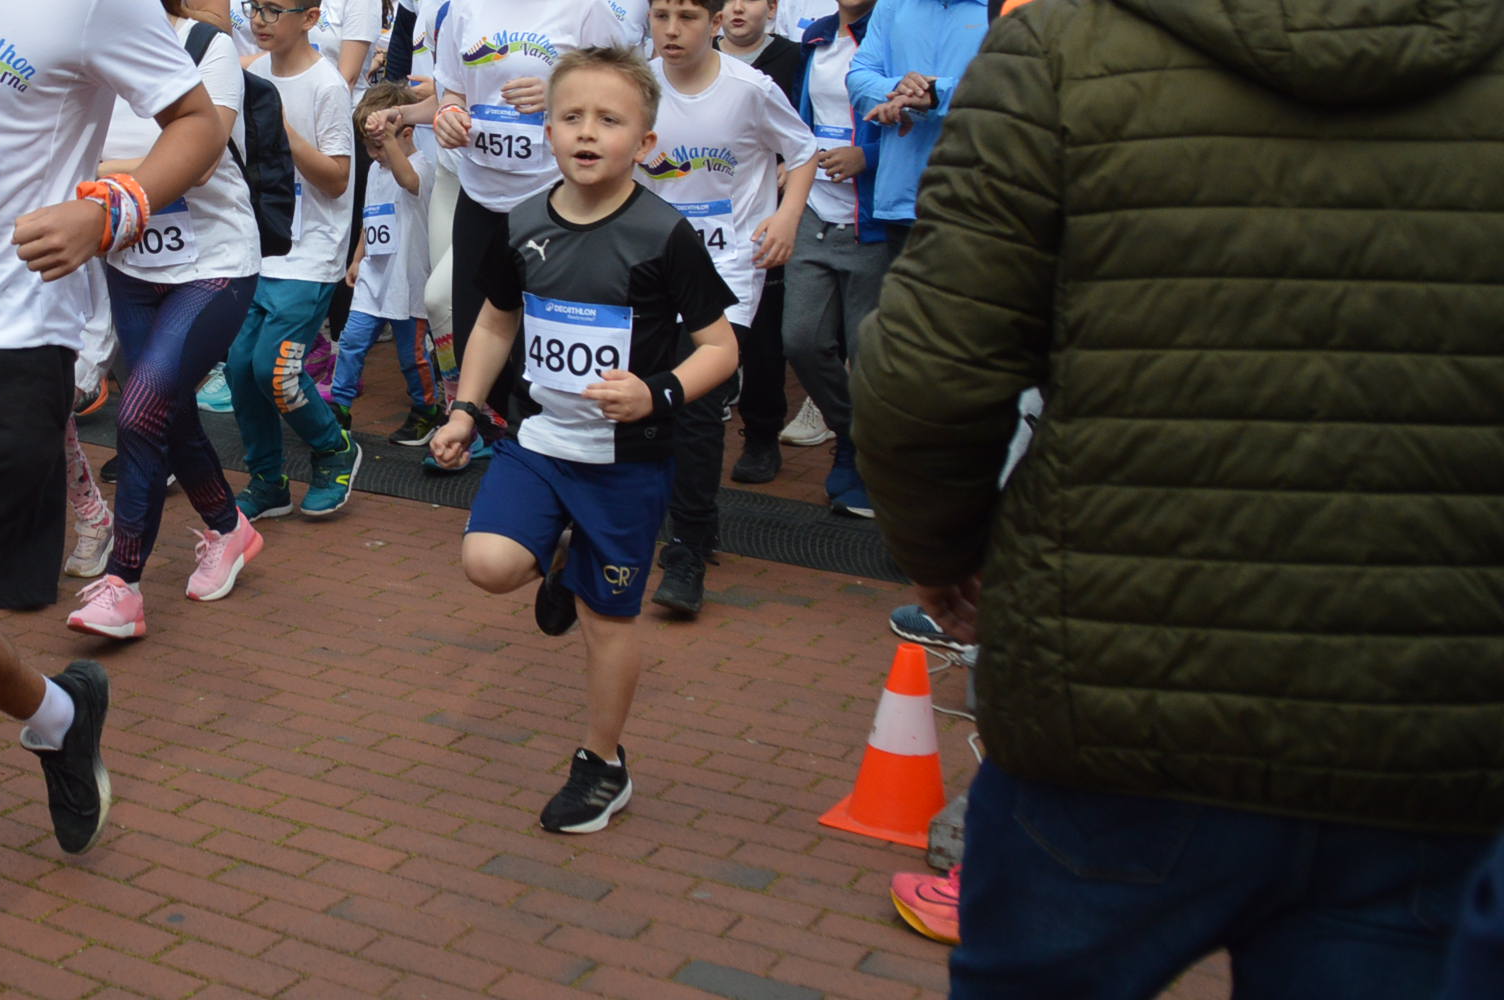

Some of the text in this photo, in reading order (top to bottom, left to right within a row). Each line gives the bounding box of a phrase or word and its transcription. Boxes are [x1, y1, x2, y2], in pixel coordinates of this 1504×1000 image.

[474, 131, 532, 159] 4513
[365, 224, 391, 245] 06
[529, 334, 620, 378] 4809
